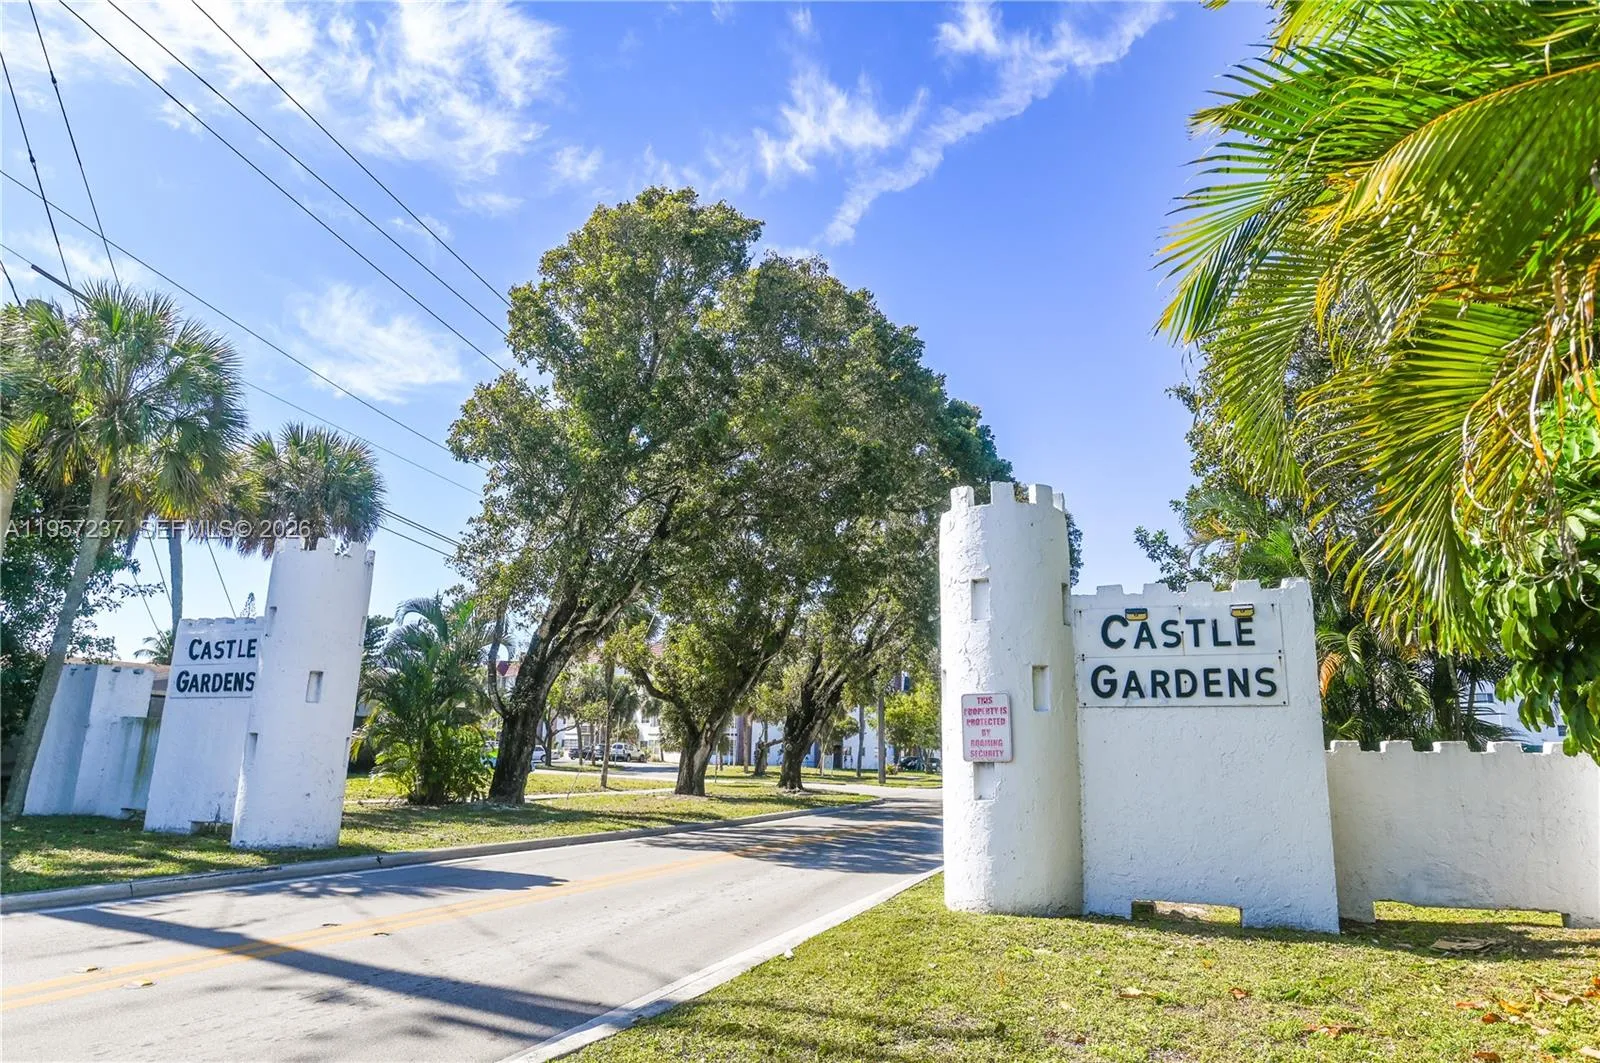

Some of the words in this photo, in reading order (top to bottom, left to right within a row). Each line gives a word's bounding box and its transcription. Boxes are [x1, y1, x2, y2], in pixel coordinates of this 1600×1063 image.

[1101, 614, 1255, 649] CASTLE
[188, 638, 258, 661] CASTLE
[176, 669, 256, 693] GARDENS
[1090, 665, 1277, 699] GARDENS
[963, 707, 998, 716] PROPERTY
[966, 718, 1005, 726] PROTECTED
[981, 729, 991, 737] BY
[970, 739, 1003, 747] ROAMING
[970, 750, 1004, 758] SECURITY
